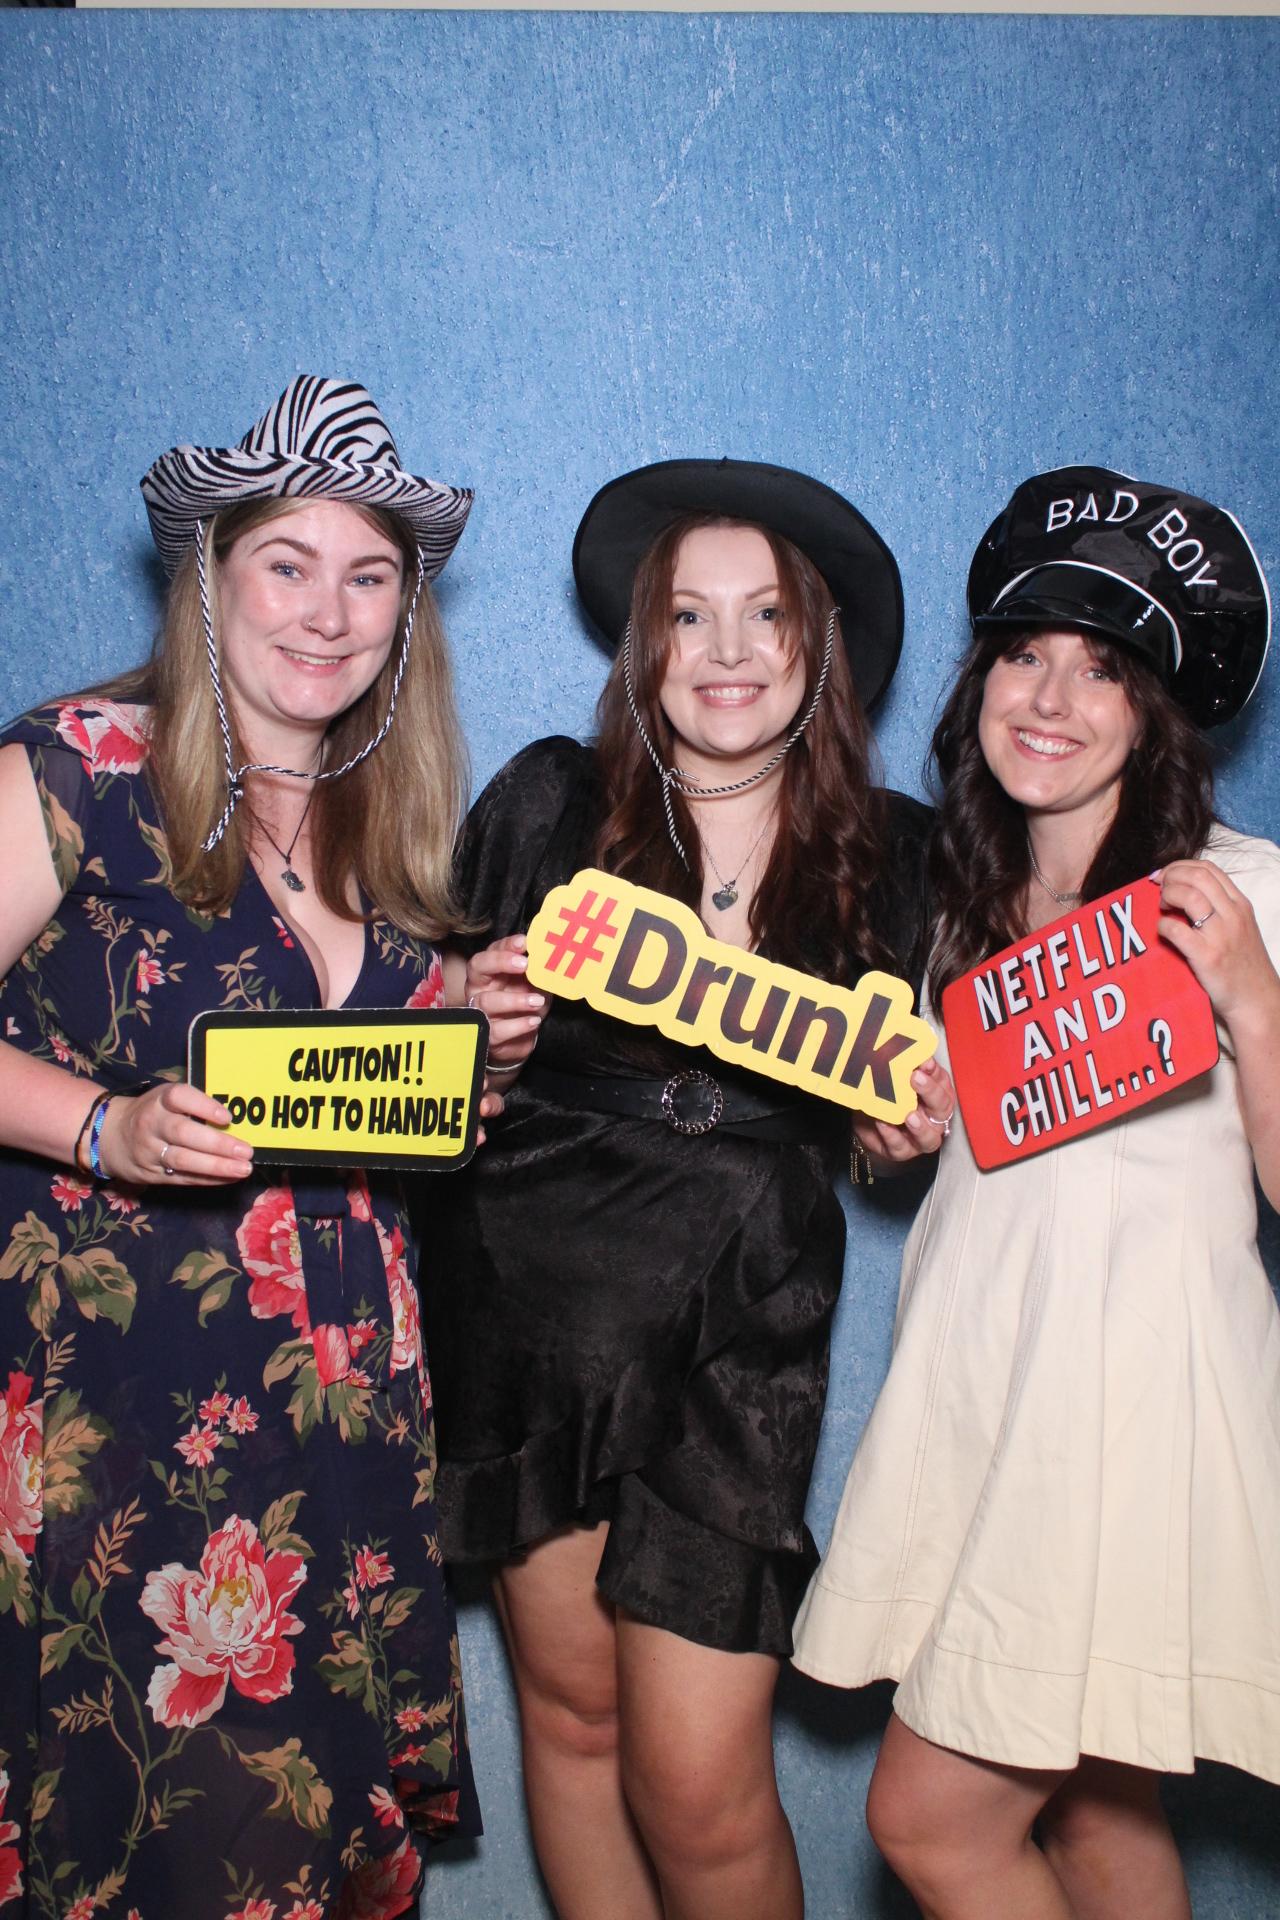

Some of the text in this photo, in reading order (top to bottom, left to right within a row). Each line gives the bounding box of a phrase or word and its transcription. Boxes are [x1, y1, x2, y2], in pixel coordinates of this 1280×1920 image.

[1046, 490, 1217, 587] BAD BOY
[544, 889, 918, 1104] #Drunk
[973, 893, 1147, 1032] NETFLIX
[288, 1040, 425, 1086] CAUTION!!
[1023, 983, 1127, 1071] AND
[271, 1095, 326, 1130] HOT
[330, 1096, 363, 1131] TO
[368, 1097, 465, 1139] HANDLE
[1000, 1018, 1176, 1146] CHILL...?
